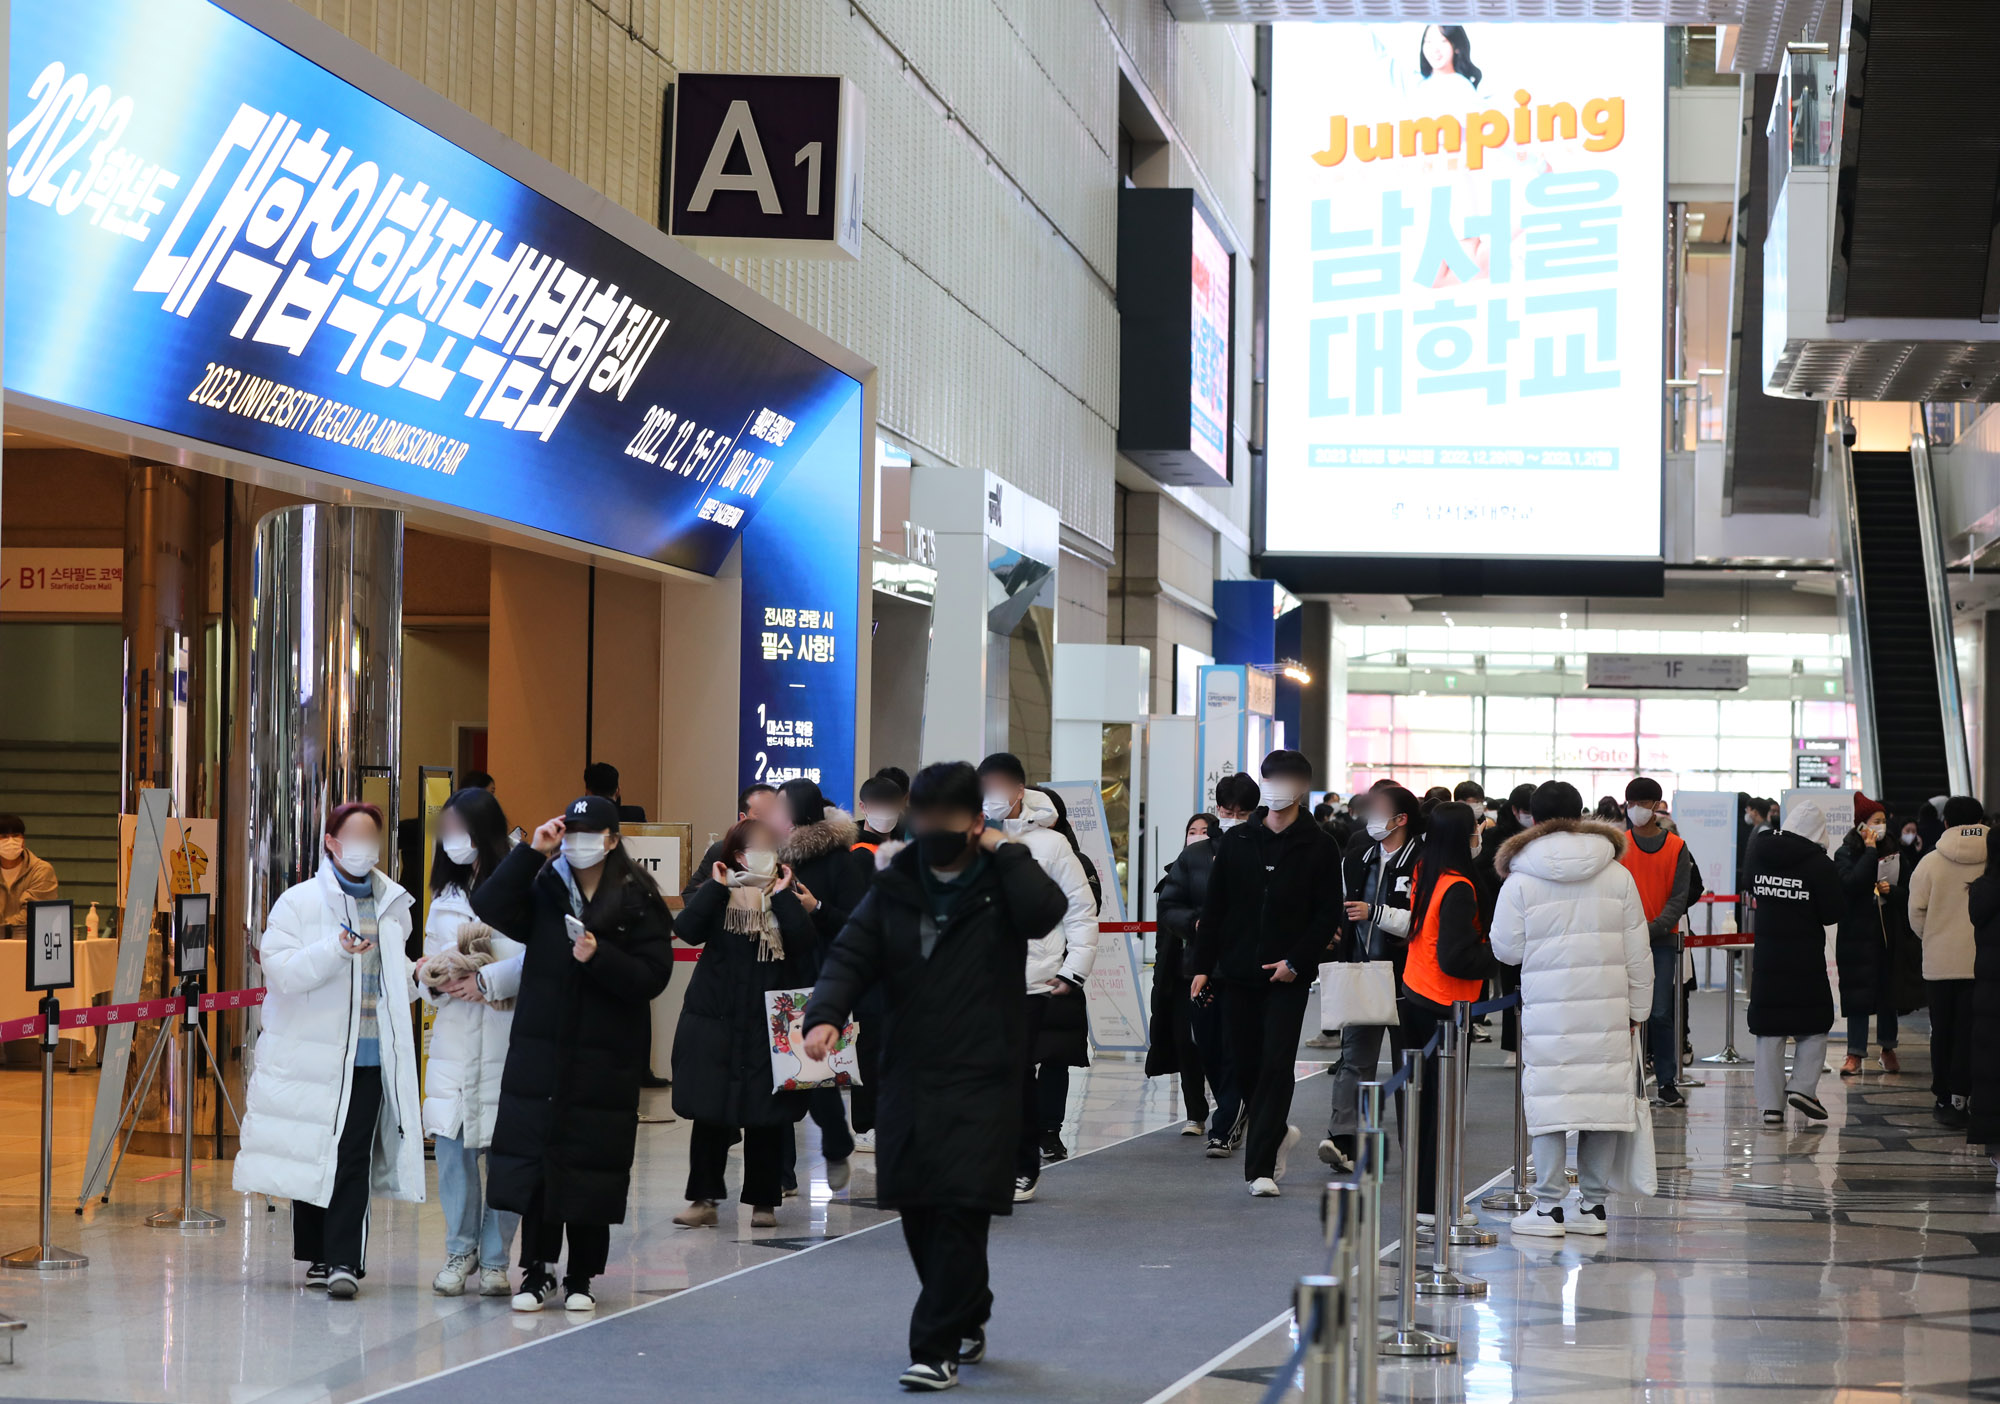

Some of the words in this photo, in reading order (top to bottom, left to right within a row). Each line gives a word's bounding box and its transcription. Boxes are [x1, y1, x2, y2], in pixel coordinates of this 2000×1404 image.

[1310, 88, 1625, 171] Jumping
[1310, 169, 1623, 303] 남서울
[1309, 287, 1621, 418] 대학교
[188, 362, 241, 410] 2023
[228, 373, 324, 432] UNIVERSITY
[307, 399, 378, 450] REGULAR
[364, 418, 447, 470] ADMISSIONS
[434, 438, 470, 476] FAIR
[1315, 449, 1347, 463] 2023
[20, 567, 45, 589] B1
[50, 567, 97, 582] 스타필드
[764, 607, 797, 628] 전시장
[798, 609, 821, 629] 관람
[822, 611, 833, 630] 시
[761, 632, 793, 661] 필수
[797, 634, 835, 663] 사항!
[1664, 661, 1683, 678] 1F
[757, 703, 766, 729] 1
[767, 720, 793, 736] 마스크
[795, 721, 813, 737] 착용
[1587, 746, 1628, 761] Gate
[755, 751, 767, 780] 2
[1963, 828, 1981, 836] 1976
[632, 858, 661, 871] XIT
[1754, 874, 1803, 889] UNDER
[44, 932, 62, 960] 입구
[107, 1007, 119, 1021] coex
[137, 1004, 149, 1018] coex
[165, 1000, 177, 1014] coex
[75, 1010, 88, 1024] coex
[22, 1018, 35, 1034] coex
